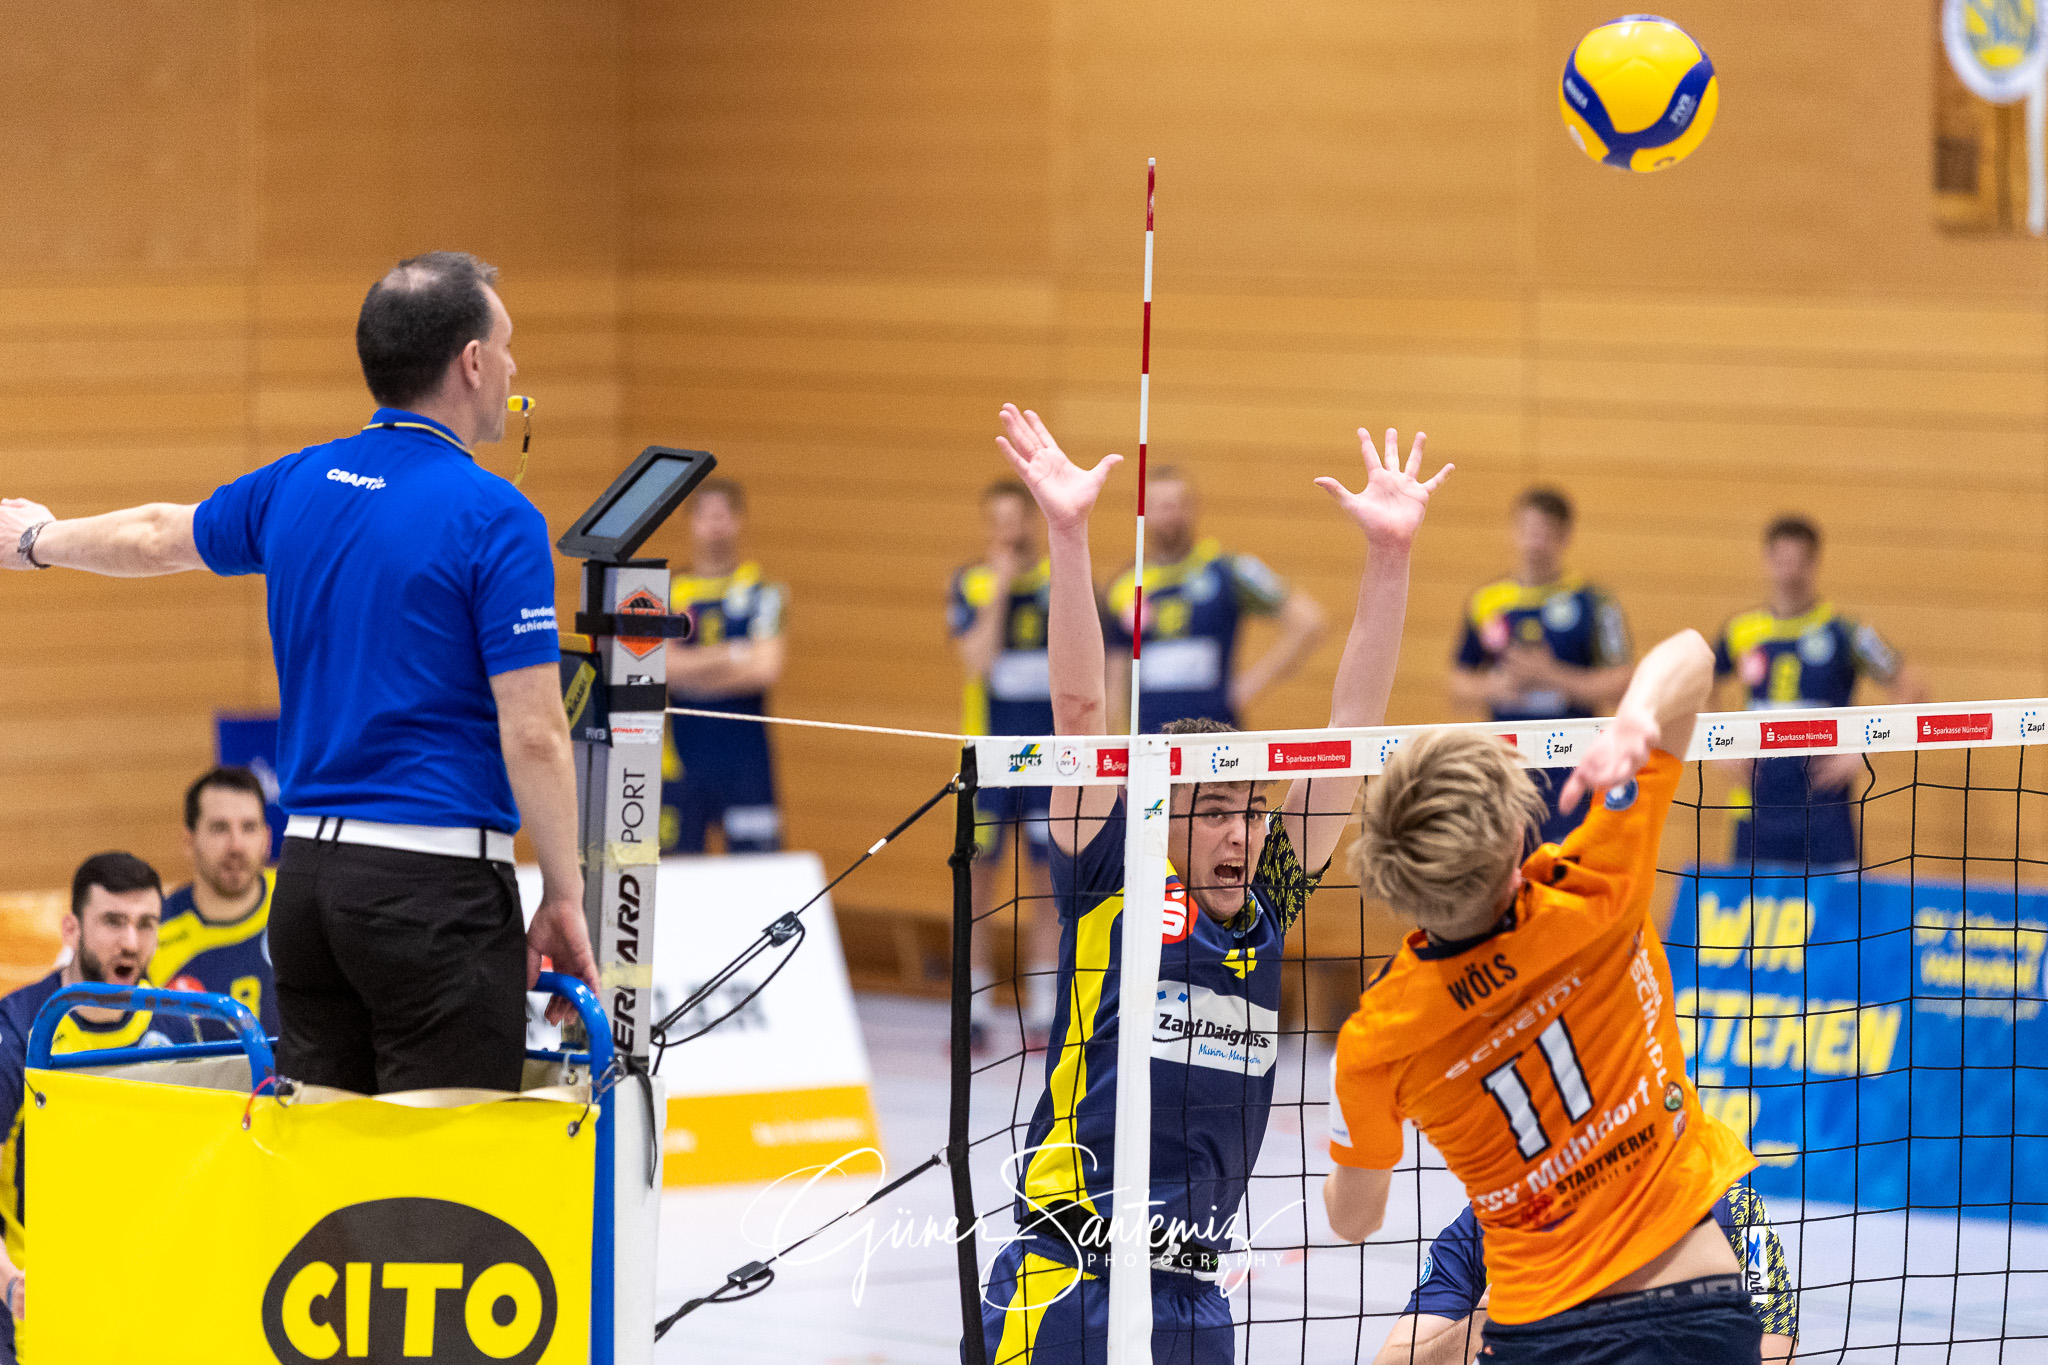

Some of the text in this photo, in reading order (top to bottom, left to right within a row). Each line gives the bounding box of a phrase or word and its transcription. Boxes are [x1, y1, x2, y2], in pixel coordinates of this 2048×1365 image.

[326, 468, 379, 491] CRAFT
[1776, 733, 1805, 742] Sparkasse
[1806, 730, 1833, 741] Nürnberg
[1872, 730, 1890, 739] Zapf
[1933, 726, 1961, 735] Sparkasse
[2027, 723, 2045, 732] Zapf
[1554, 743, 1573, 753] Zapf
[1715, 736, 1734, 746] Zapf
[1219, 758, 1239, 768] Zapf
[1285, 755, 1316, 764] Sparkasse
[1317, 753, 1346, 763] Nürnberg
[621, 768, 645, 843] PORT
[1697, 890, 1815, 974] WIR
[612, 874, 640, 1056] ERARD
[1447, 953, 1518, 1011] WÖLS
[1158, 1013, 1203, 1036] Zapf
[1675, 987, 1901, 1078] STEHEN
[1482, 1015, 1594, 1163] 11
[281, 1260, 543, 1360] CITO
